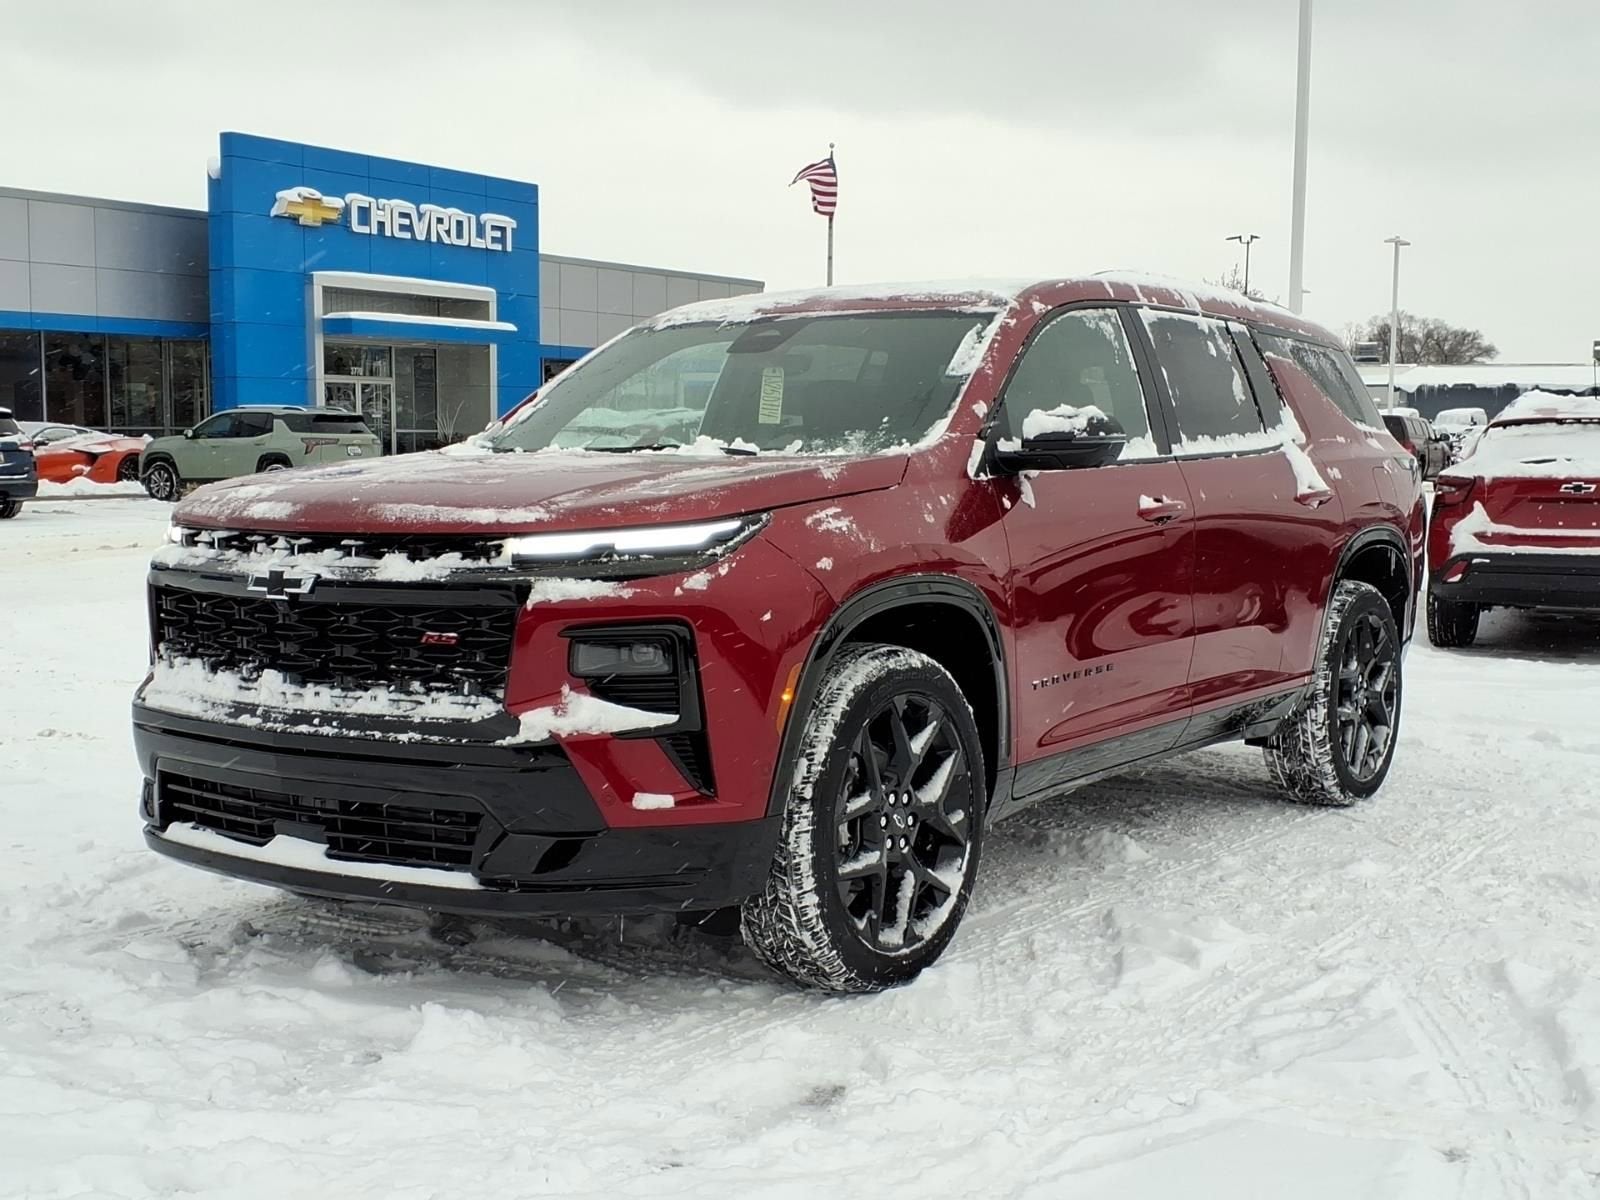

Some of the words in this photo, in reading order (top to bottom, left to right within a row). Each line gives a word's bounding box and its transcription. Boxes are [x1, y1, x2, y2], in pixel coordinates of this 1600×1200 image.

[348, 197, 516, 253] CHEVROLET
[421, 631, 458, 645] RS
[1031, 663, 1115, 691] TRAVERSE
